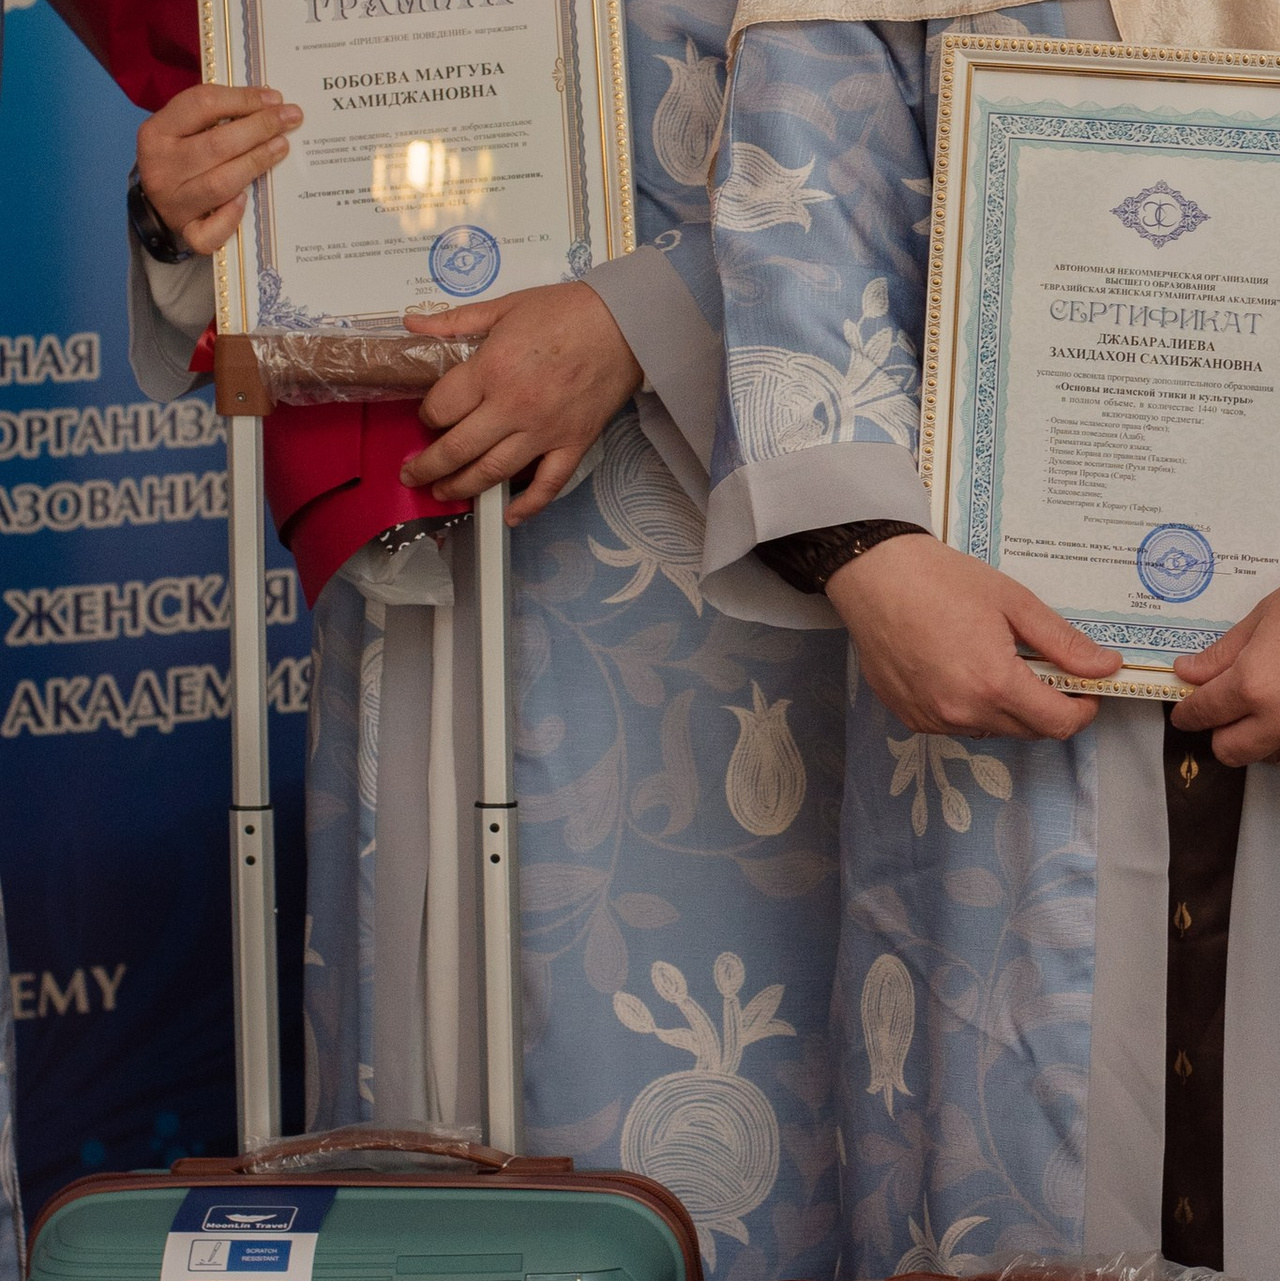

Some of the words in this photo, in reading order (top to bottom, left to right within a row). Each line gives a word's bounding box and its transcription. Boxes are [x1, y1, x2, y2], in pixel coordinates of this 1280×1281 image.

[323, 71, 410, 91] БОБОЕВА
[415, 62, 505, 82] МАРГУБА
[332, 84, 498, 112] ХАМИДЖАНОВНА
[1054, 264, 1116, 275] АВТОНОМНАЯ
[1117, 268, 1202, 281] НЕКОММЕРЧЕСКАЯ
[1204, 273, 1269, 286] ОРГАНИЗАЦИЯ
[1104, 277, 1151, 287] ВЫСШЕГО
[1152, 280, 1216, 292] ОБРАЗОВАНИЯ
[1108, 287, 1152, 298] ЖЕНСКАЯ
[1154, 290, 1226, 302] ГУМАНИТАРНАЯ
[1050, 298, 1263, 335] СЕРТИФИКАТ
[1096, 332, 1216, 352] ДЖАБАРАЛИЕВА
[1049, 346, 1136, 363] ЗАХИДАХОН
[1140, 352, 1263, 372] САХИБЖАНОВНА
[1102, 386, 1156, 398] исламской
[1158, 391, 1188, 400] этики
[1148, 402, 1194, 412] количестве
[1198, 404, 1218, 413] 1440
[4, 568, 298, 646] ЖЕНСКЯ
[1130, 600, 1148, 610] 2025
